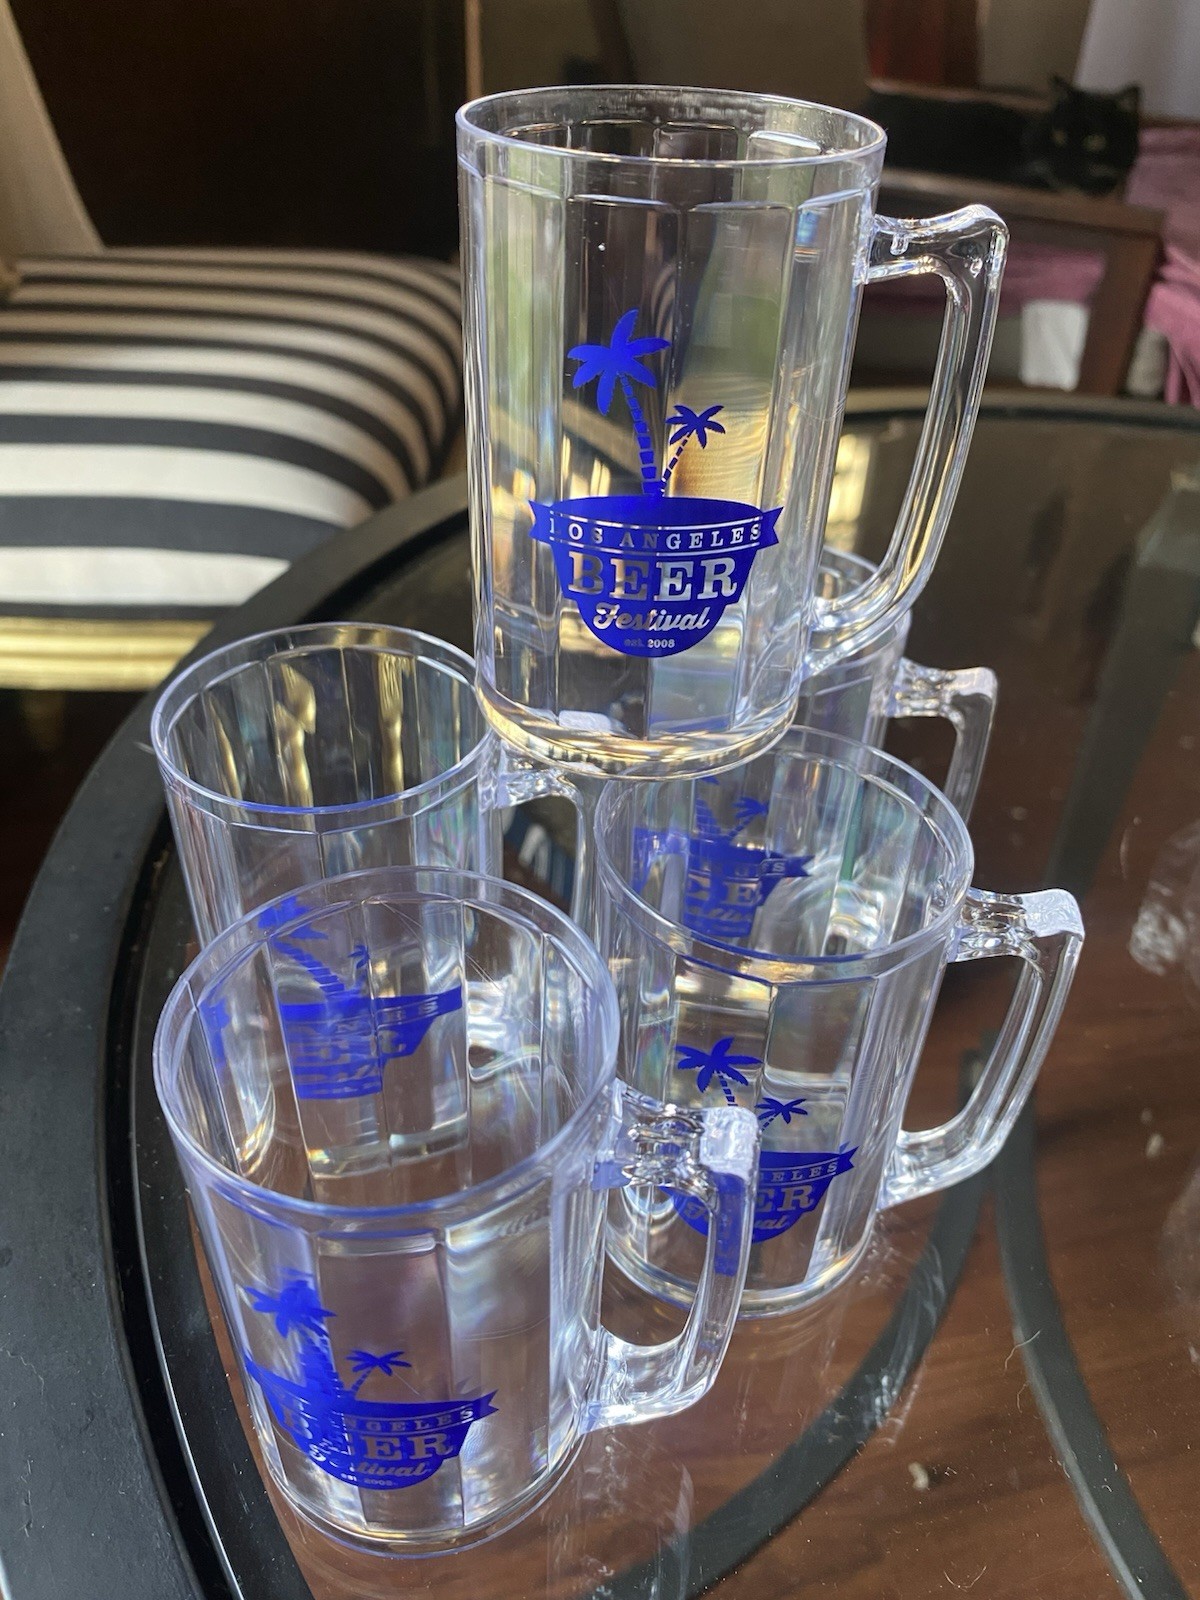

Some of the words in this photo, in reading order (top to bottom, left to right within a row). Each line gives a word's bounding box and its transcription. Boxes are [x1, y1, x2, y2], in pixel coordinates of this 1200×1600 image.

[619, 523, 762, 549] ANGELES
[568, 550, 738, 602] BEER
[593, 602, 710, 632] Festival
[647, 638, 676, 648] 2008
